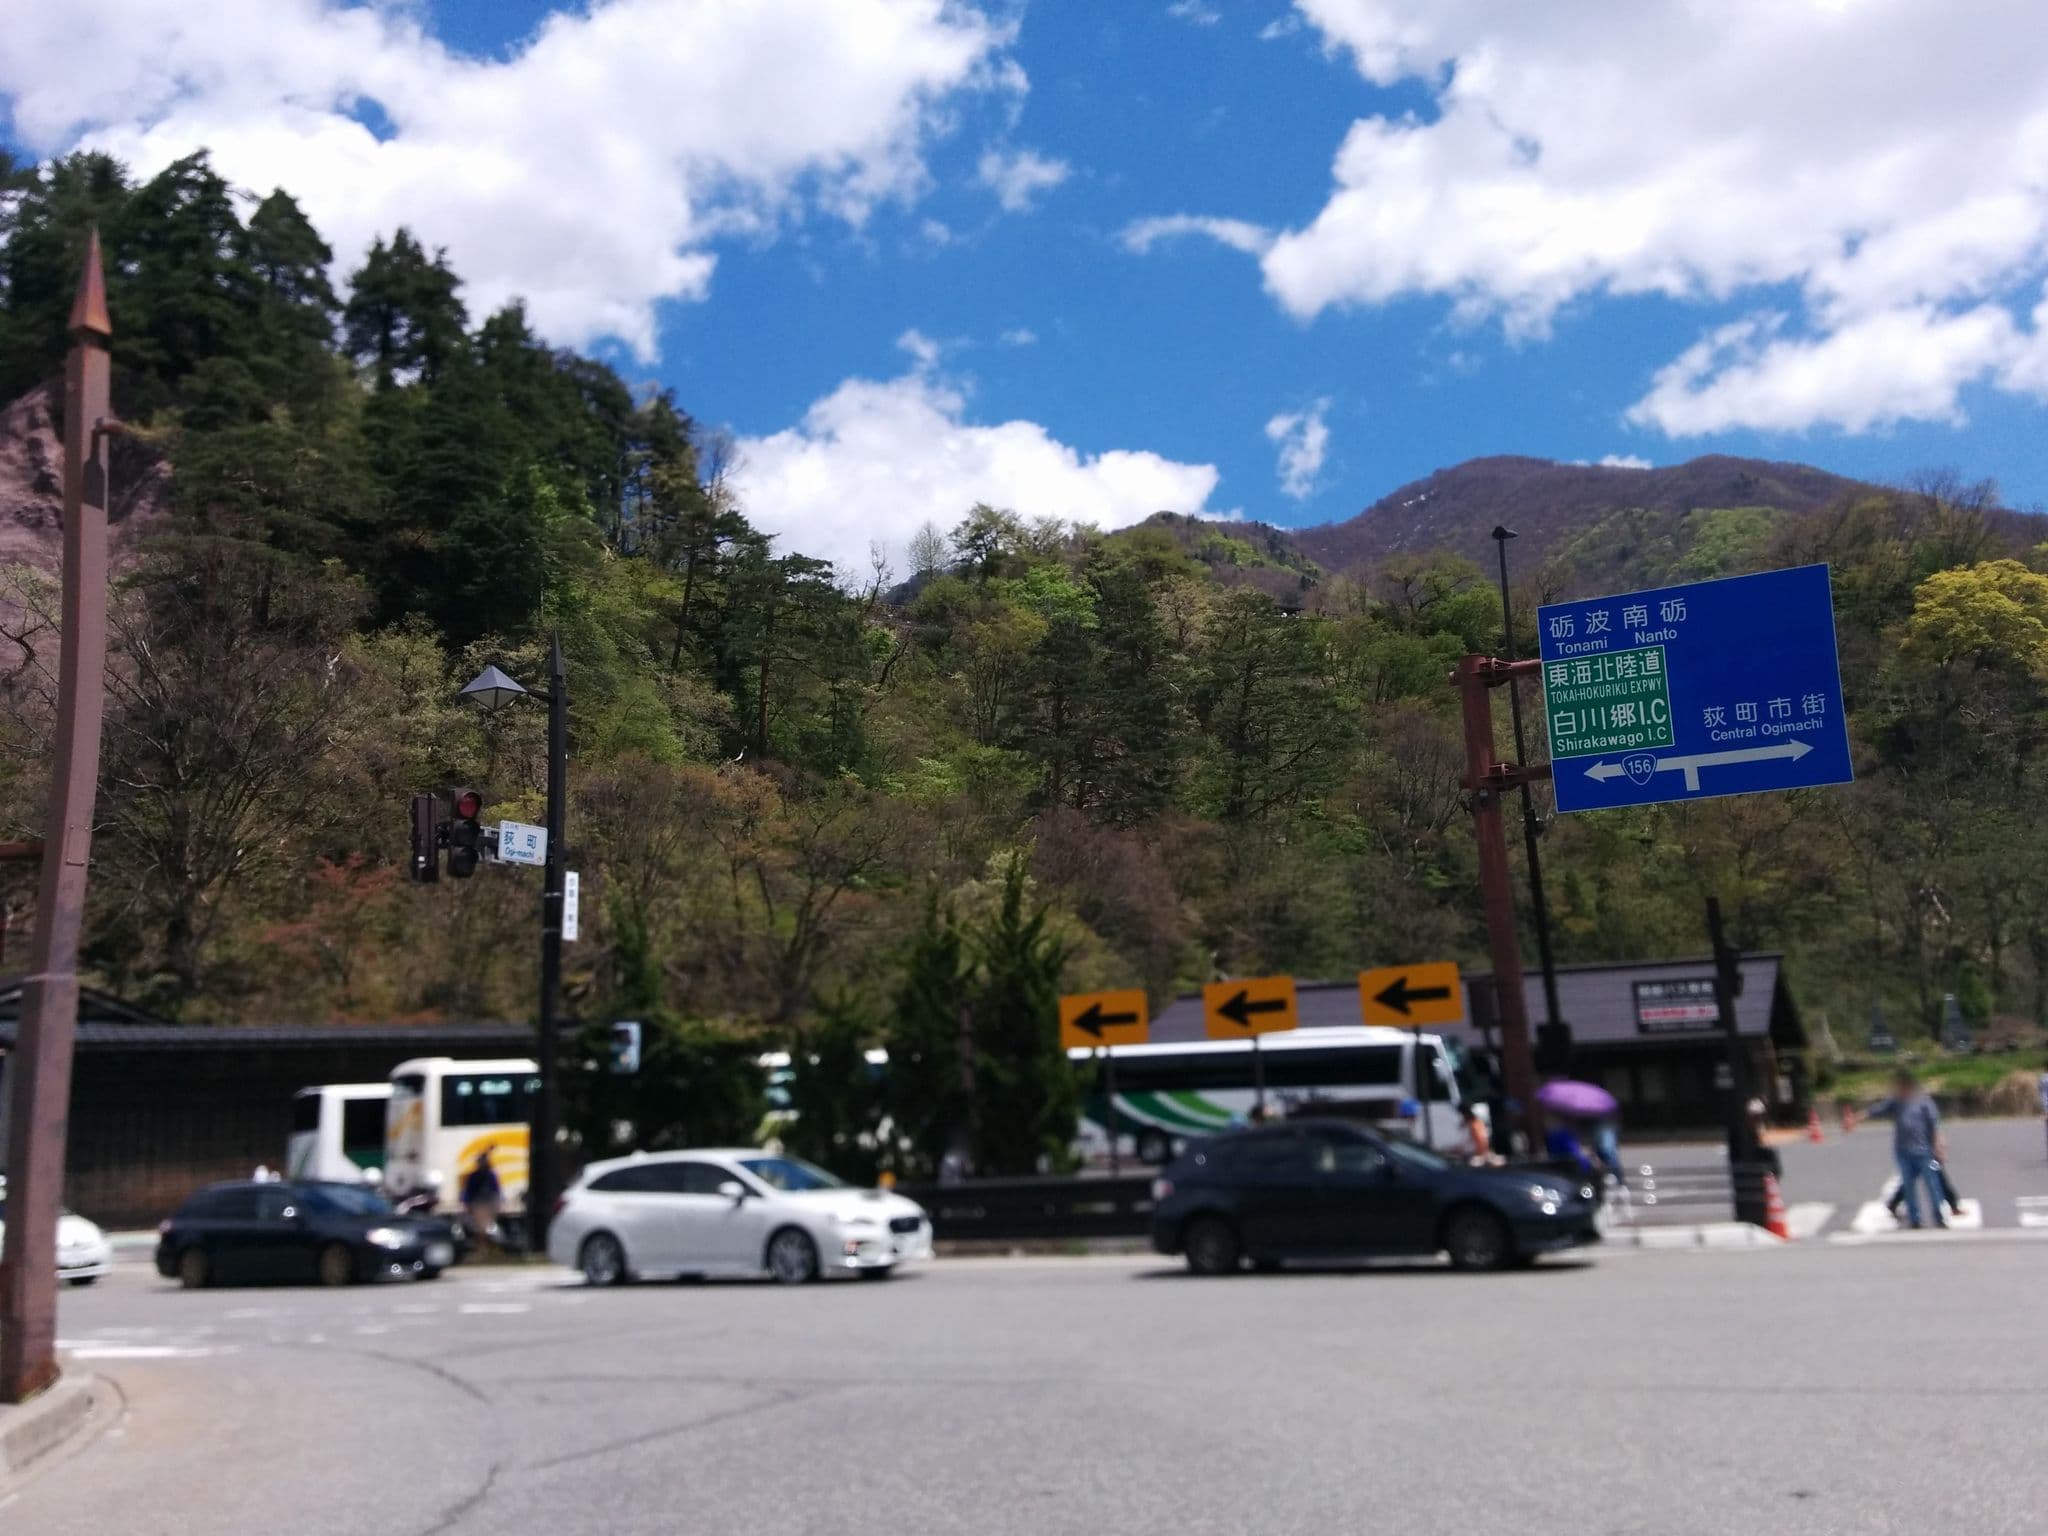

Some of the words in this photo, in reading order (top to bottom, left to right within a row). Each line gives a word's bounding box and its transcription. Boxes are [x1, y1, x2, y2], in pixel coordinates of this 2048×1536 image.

[1556, 636, 1608, 655] Tonami
[1635, 628, 1678, 644] Nanto
[1548, 650, 1661, 688] 東海北陸道
[1551, 684, 1628, 704] TOKAI-HOKURIKU
[1630, 678, 1662, 695] EXPWY
[1703, 693, 1826, 728] 荻町市街
[1556, 731, 1644, 752] Shirakawago
[1648, 727, 1667, 742] I.C
[1711, 726, 1756, 742] Central
[1761, 717, 1823, 736] Ogimachi
[1628, 759, 1651, 775] 156
